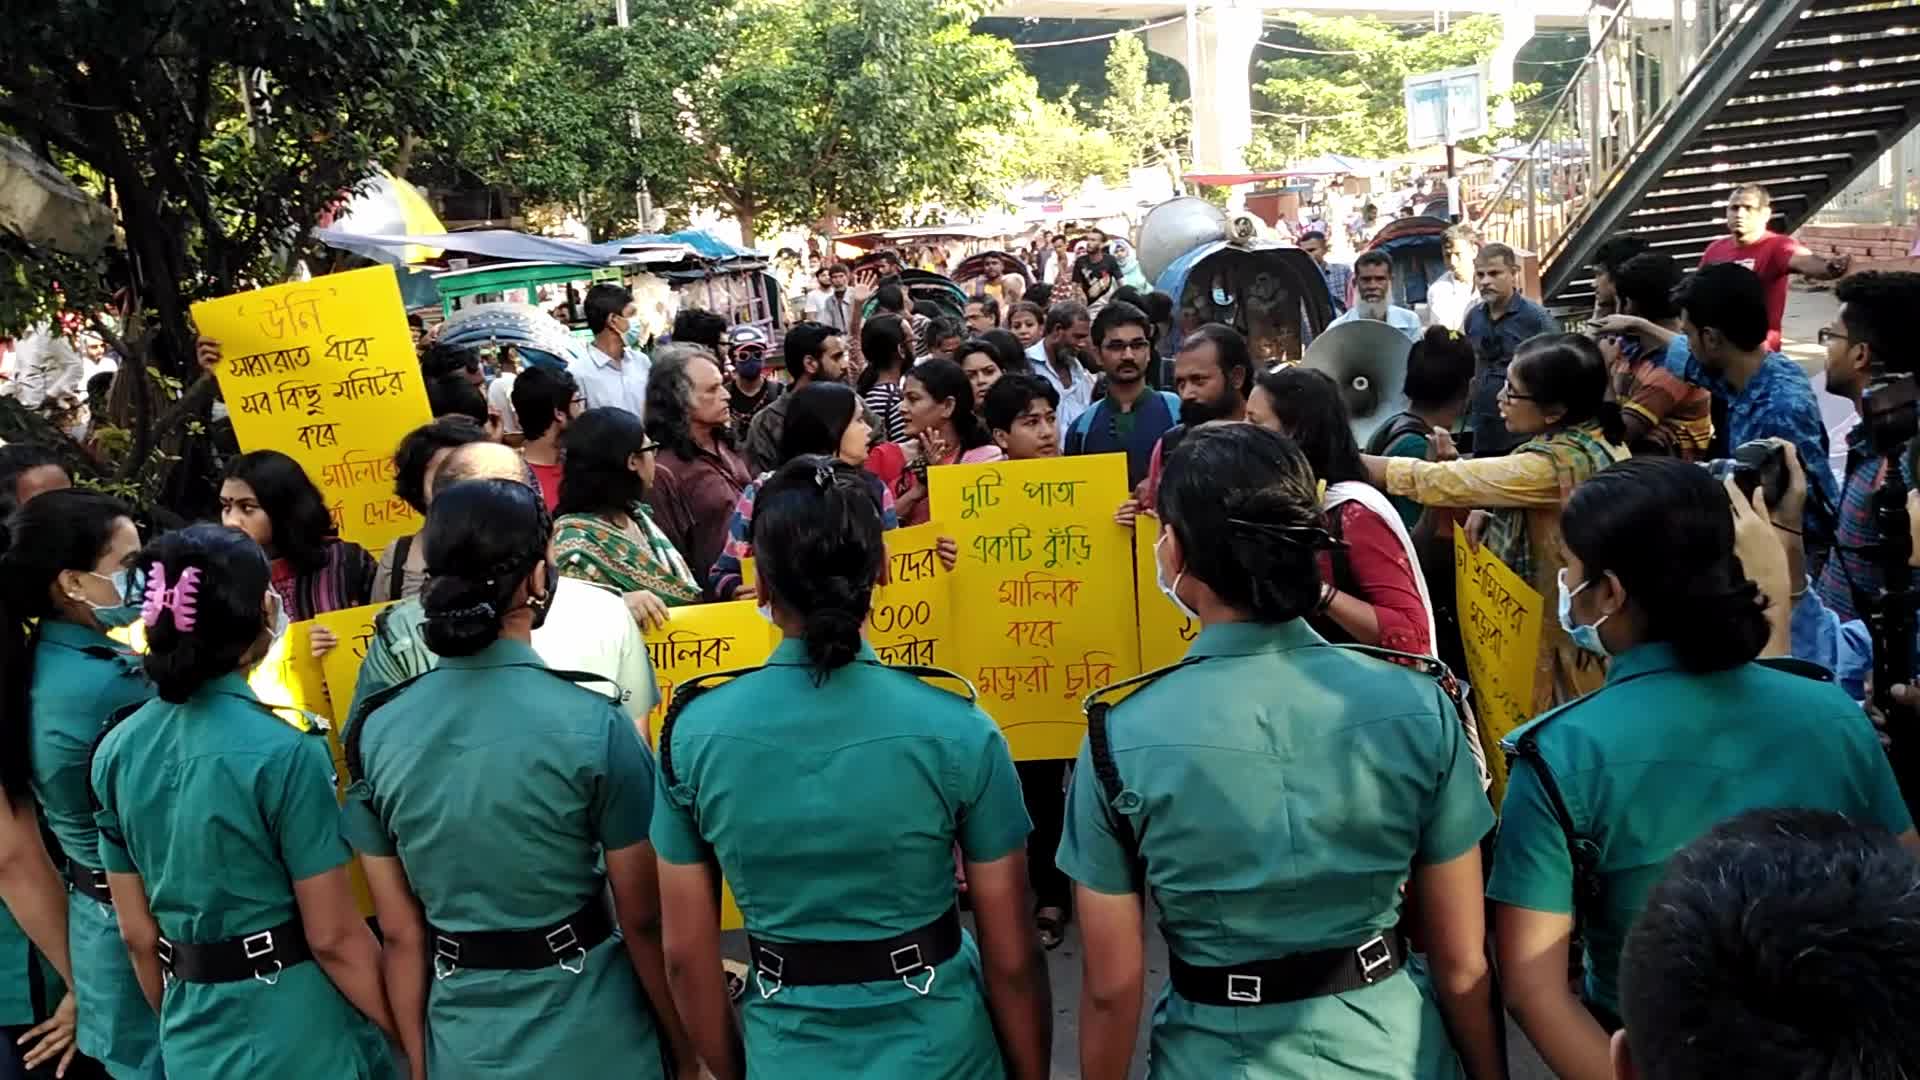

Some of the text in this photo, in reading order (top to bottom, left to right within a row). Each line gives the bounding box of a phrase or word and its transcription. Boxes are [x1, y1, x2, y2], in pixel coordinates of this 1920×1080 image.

[240, 367, 407, 416] সব কিছু মনিটর
[296, 423, 342, 449] করে
[960, 467, 1088, 520] দুটি পাতা
[968, 523, 1092, 568] একটি কুঁড়ি
[998, 571, 1085, 608] মালিক
[1006, 620, 1063, 648] করে
